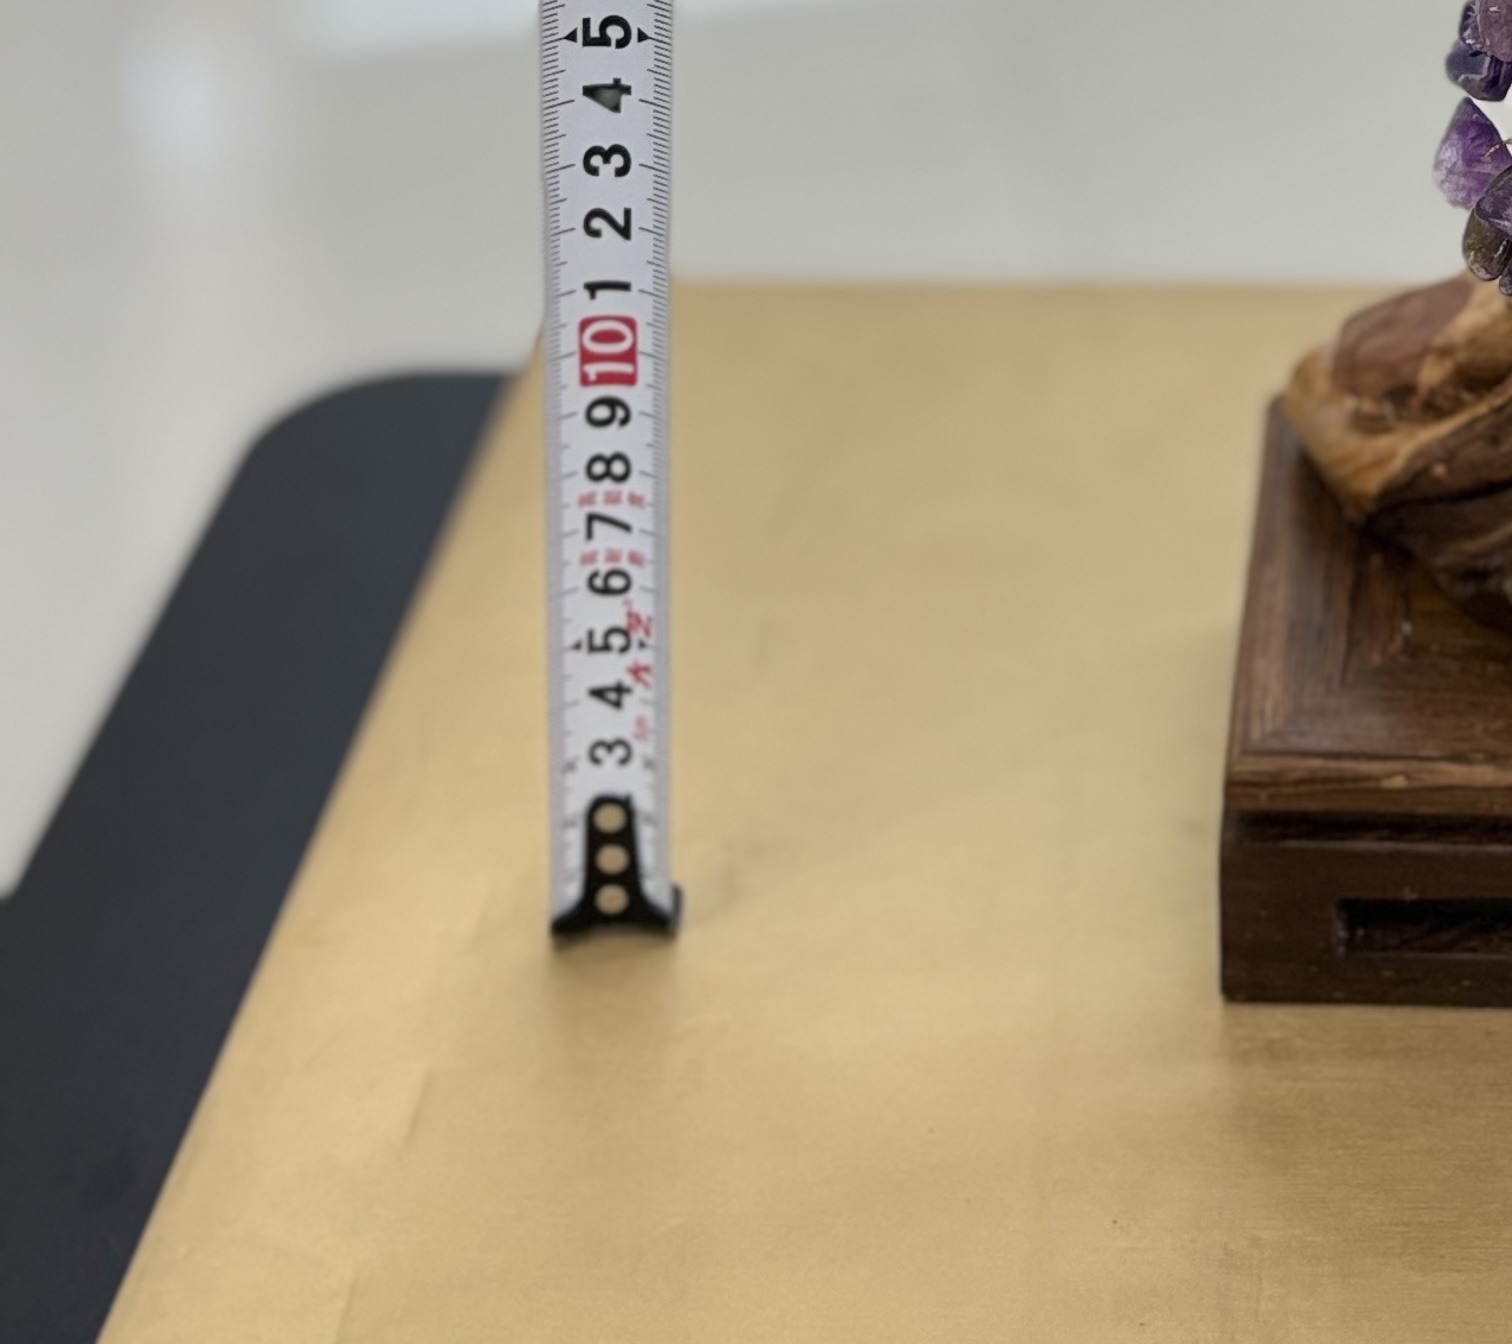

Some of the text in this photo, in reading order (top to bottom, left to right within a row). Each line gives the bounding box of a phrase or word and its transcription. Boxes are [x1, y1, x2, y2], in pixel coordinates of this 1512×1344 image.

[581, 13, 632, 51] 5
[582, 76, 632, 115] 4
[582, 142, 632, 179] 3
[583, 206, 632, 242] 2
[583, 279, 631, 301] 1
[581, 318, 635, 382] 10
[585, 395, 631, 429] 9
[585, 451, 631, 484] 8
[586, 512, 631, 541] 7
[587, 568, 632, 597] 6
[588, 626, 631, 655] 5
[589, 681, 631, 710] 4
[588, 737, 632, 766] 3
